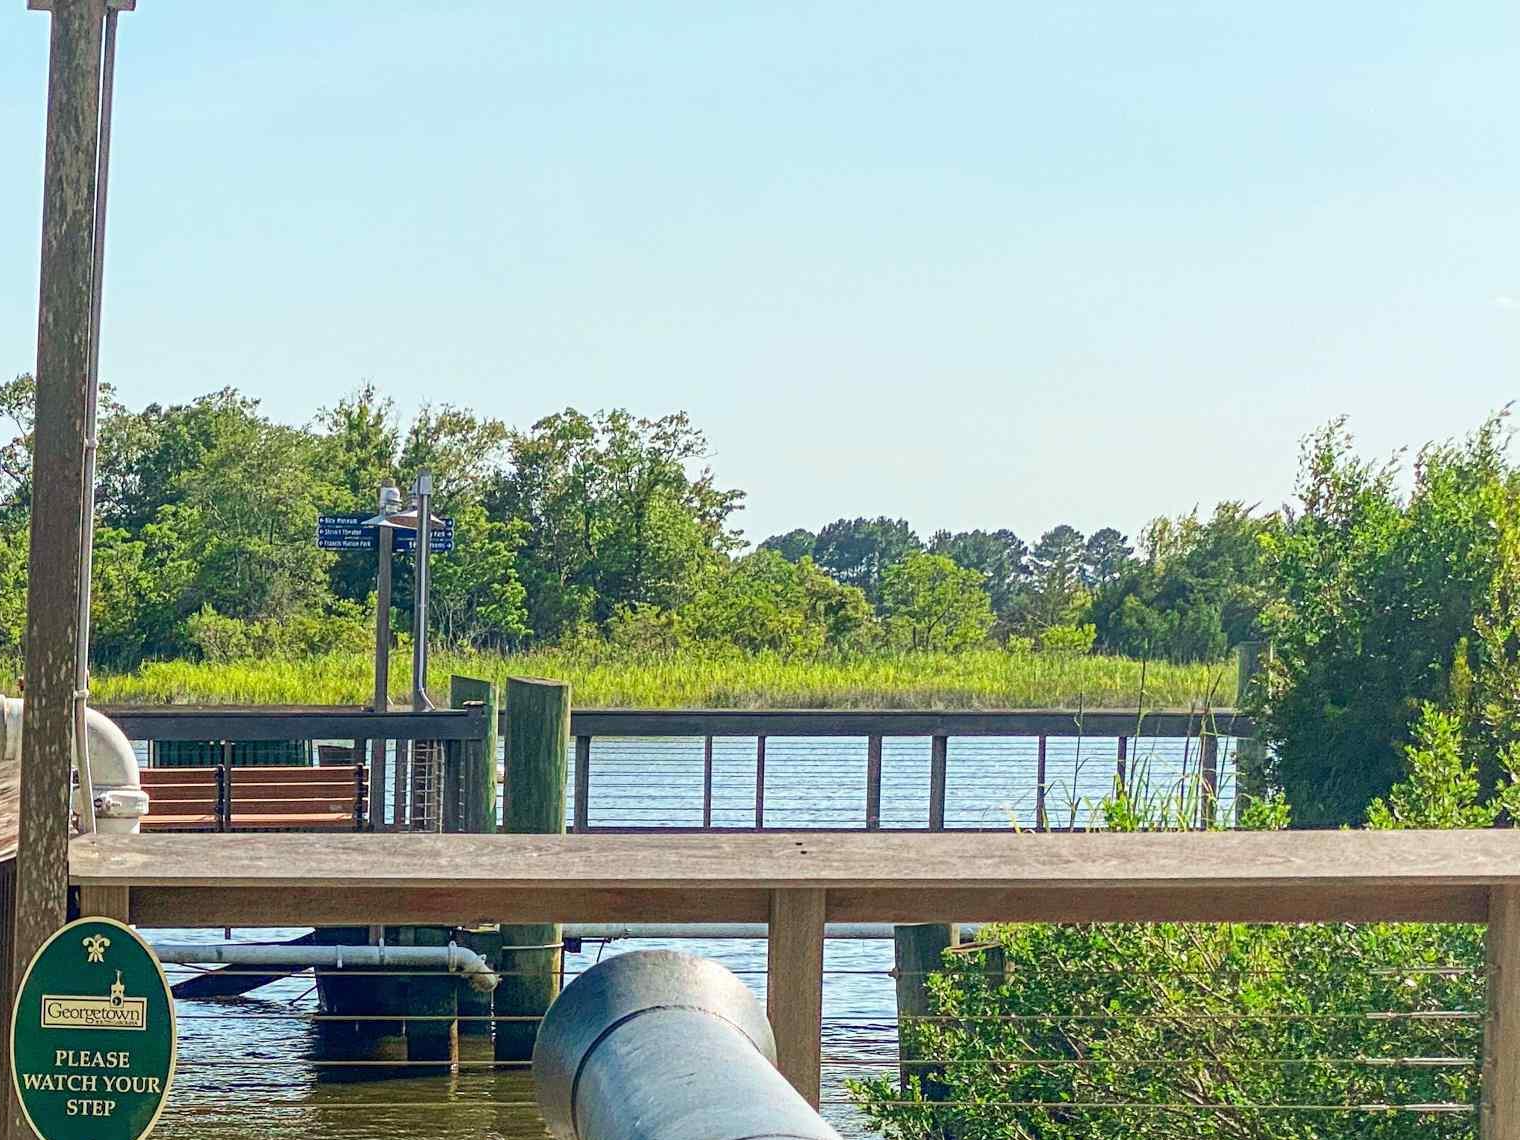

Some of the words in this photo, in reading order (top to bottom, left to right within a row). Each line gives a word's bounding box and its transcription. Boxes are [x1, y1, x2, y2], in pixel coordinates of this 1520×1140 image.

[47, 1002, 140, 1025] Georgetown
[55, 1050, 130, 1069] PLEASE
[22, 1073, 96, 1092] WATCH
[102, 1076, 161, 1094] YOUR
[66, 1099, 116, 1117] STEP
